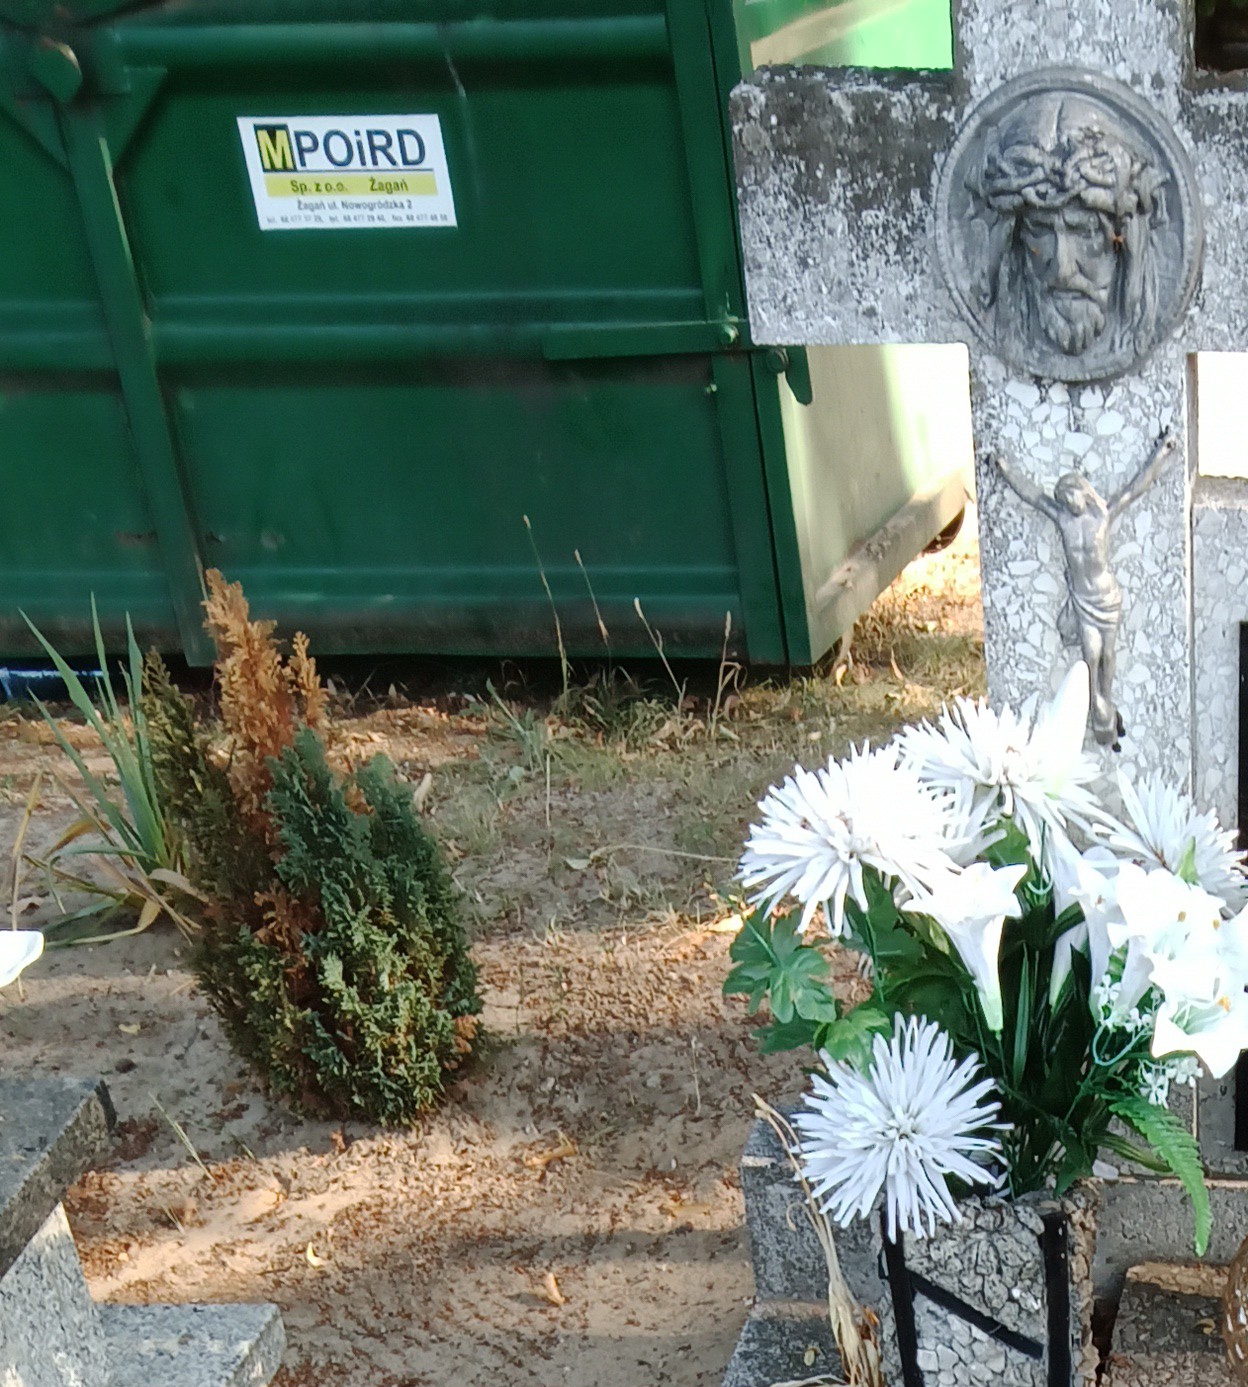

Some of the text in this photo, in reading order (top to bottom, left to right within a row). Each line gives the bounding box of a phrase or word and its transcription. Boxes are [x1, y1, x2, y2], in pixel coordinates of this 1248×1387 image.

[254, 125, 426, 170] MPOiRD
[290, 176, 409, 195] Sp. z o.o. Żagań
[407, 199, 413, 209] 2
